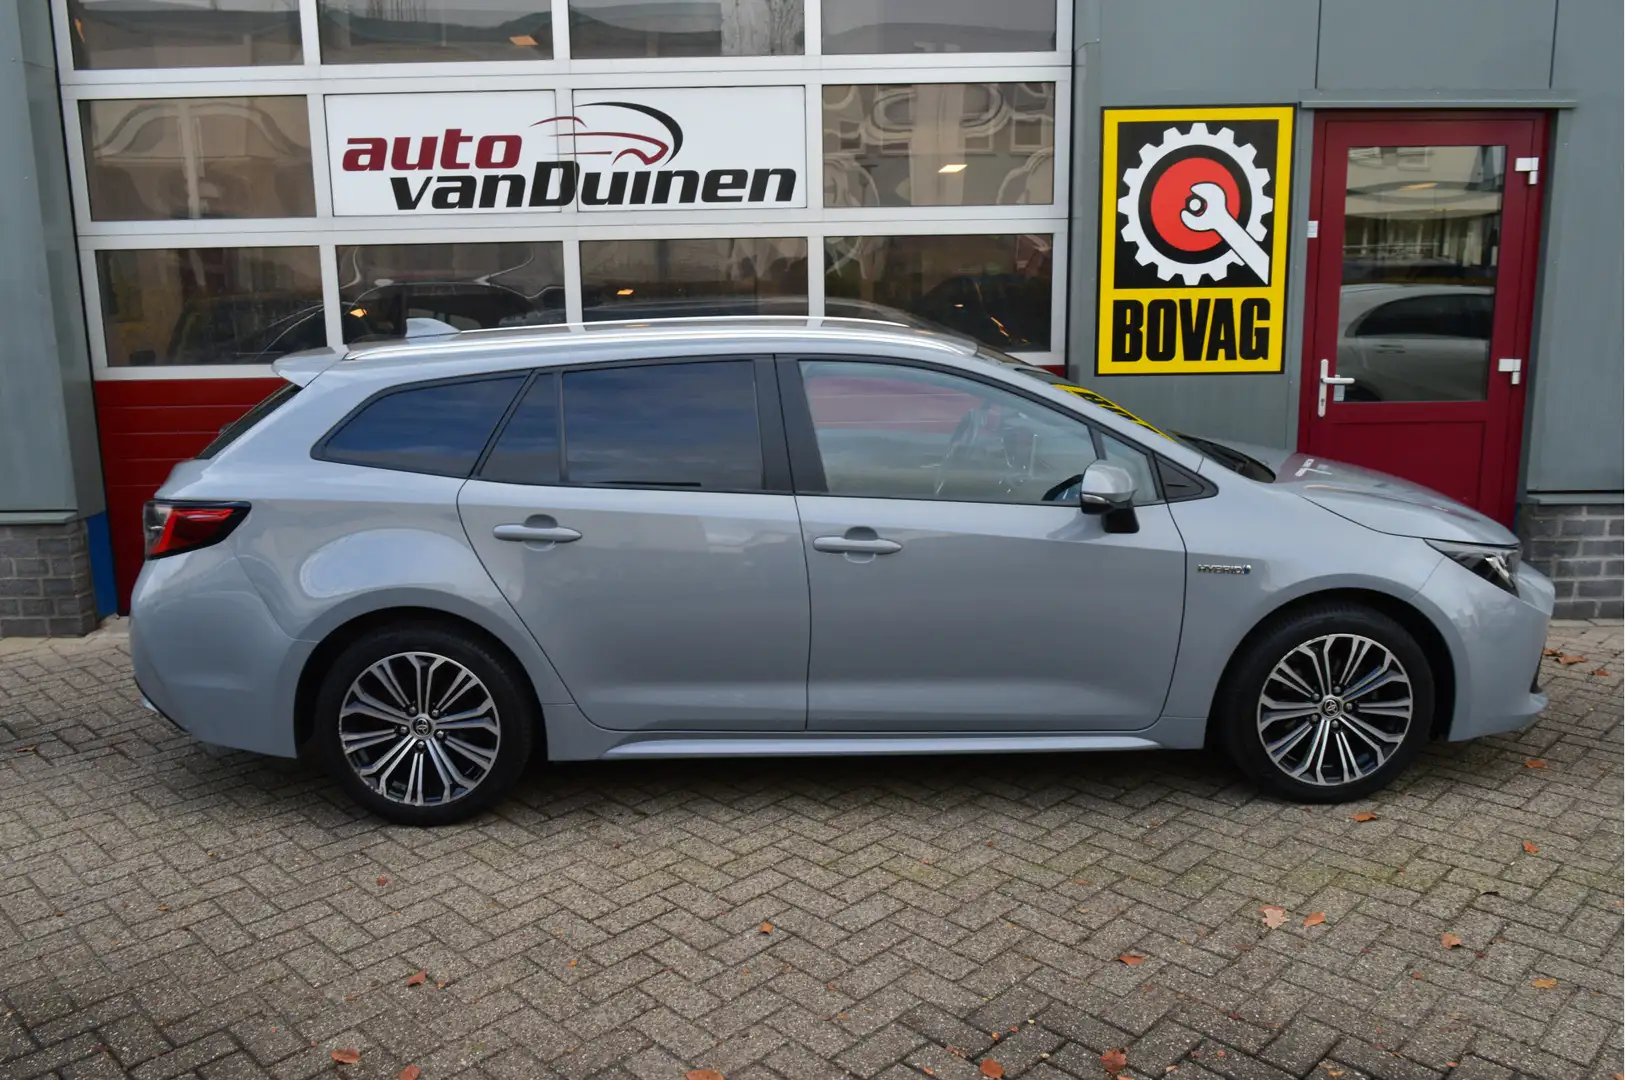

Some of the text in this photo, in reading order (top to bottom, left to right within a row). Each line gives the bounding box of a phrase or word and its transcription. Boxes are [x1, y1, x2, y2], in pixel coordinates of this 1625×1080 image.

[342, 128, 522, 171] auto
[389, 161, 797, 211] vanDuinen
[1111, 298, 1271, 362] BOVAG
[1197, 564, 1242, 574] HYBRID
